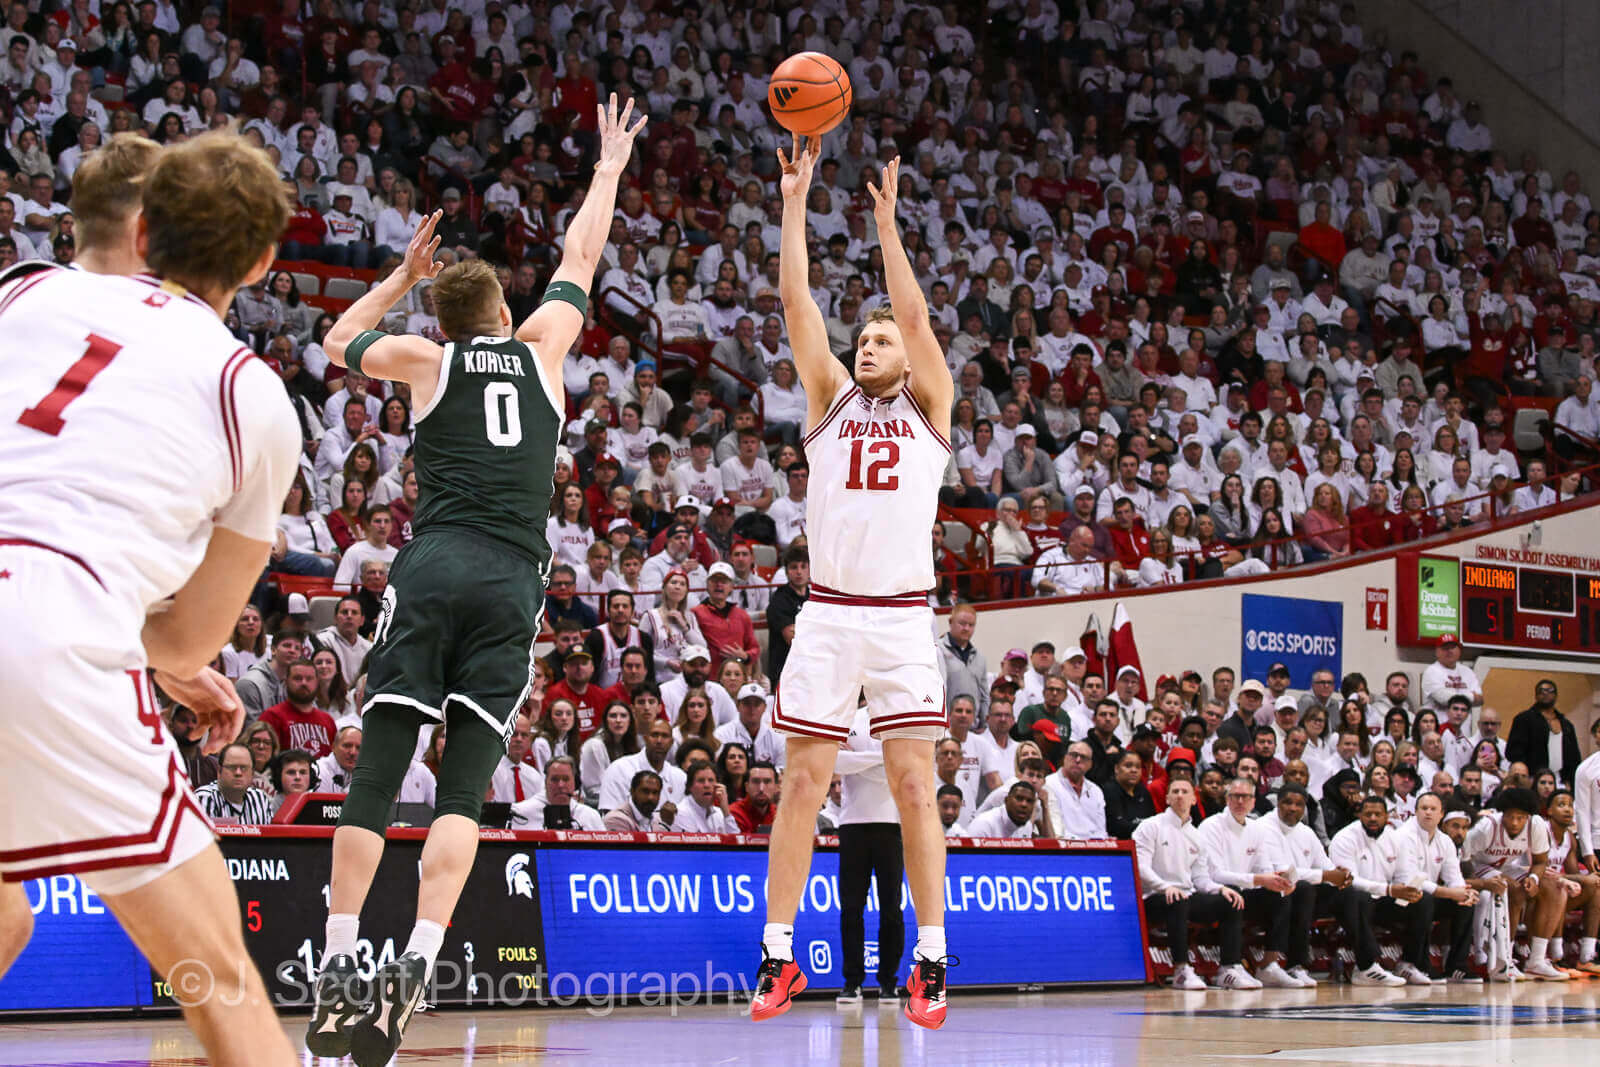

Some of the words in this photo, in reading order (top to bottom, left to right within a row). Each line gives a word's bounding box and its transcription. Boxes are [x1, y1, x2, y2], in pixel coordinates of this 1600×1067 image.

[463, 351, 526, 377] KOHLER
[16, 332, 124, 437] 1
[484, 382, 522, 447] 0
[846, 440, 899, 490] 12
[1544, 553, 1587, 569] ASSEMBLY
[1465, 566, 1515, 590] INDIANA
[1373, 603, 1381, 625] 4
[1487, 602, 1497, 632] 5
[1257, 631, 1284, 652] CBS
[1286, 634, 1336, 656] SPORTS
[1526, 624, 1550, 640] PERIOD
[569, 874, 701, 914] FOLLOW
[712, 874, 755, 913] US
[247, 901, 263, 932] 5
[464, 942, 475, 962] 3
[498, 947, 538, 962] FOULS
[468, 975, 479, 995] 4
[516, 975, 540, 990] TOL
